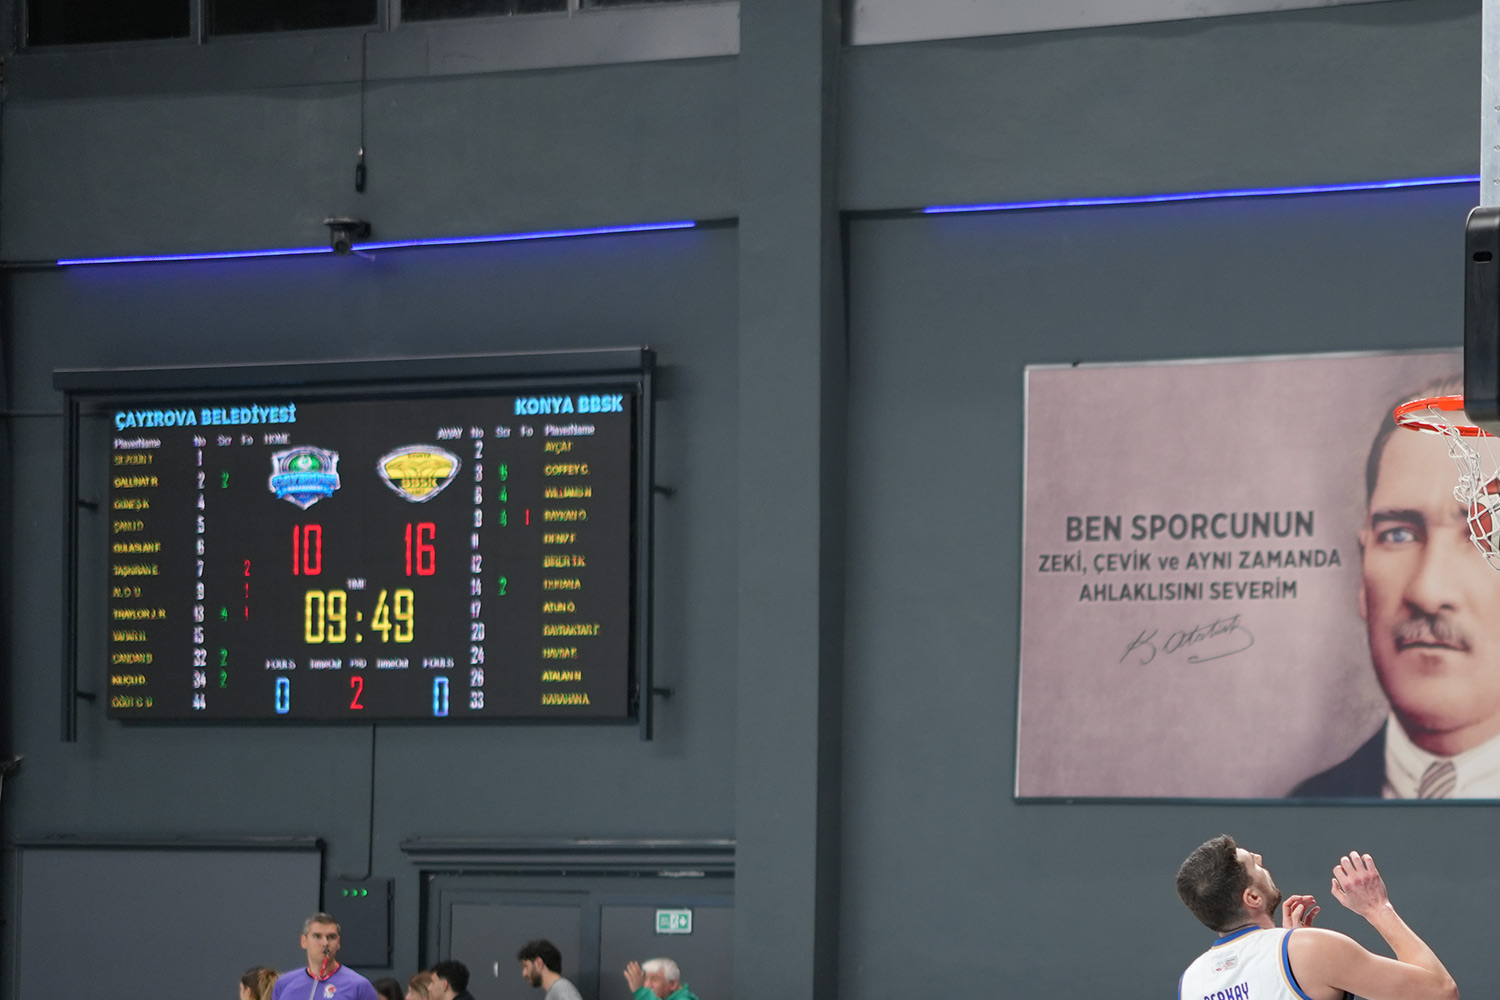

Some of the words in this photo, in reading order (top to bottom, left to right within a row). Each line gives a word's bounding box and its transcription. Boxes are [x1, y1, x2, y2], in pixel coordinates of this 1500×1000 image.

[514, 396, 574, 415] KONYA
[577, 395, 623, 414] BBSK
[115, 409, 198, 431] ÇAYIROVA
[201, 402, 297, 426] BELEDİYESİ
[437, 427, 463, 440] AWAY
[474, 440, 483, 459] 2
[474, 463, 483, 482] 3
[196, 515, 205, 533] 5
[1066, 515, 1122, 542] BEN
[1131, 511, 1314, 541] SPORCUNUN
[293, 524, 322, 576] 10
[405, 522, 436, 576] 16
[244, 559, 251, 576] 2
[470, 555, 482, 574] 12
[1038, 550, 1087, 575] ZEKİ,
[1093, 550, 1151, 575] ÇEVİK
[1158, 555, 1180, 571] ve
[1186, 551, 1232, 570] AYNI
[1239, 548, 1342, 569] ZAMANDA
[470, 577, 482, 596] 14
[1079, 582, 1203, 602] AHLAKLISINI
[1210, 577, 1298, 600] SEVERİM
[305, 589, 414, 643] 09:49
[470, 600, 481, 619] 17
[470, 622, 485, 641] 20
[193, 648, 208, 667] 32
[470, 645, 485, 664] 24
[192, 670, 207, 688] 34
[192, 692, 206, 710] 44
[276, 677, 290, 714] 0
[350, 676, 364, 710] 2
[433, 676, 449, 717] 0
[470, 690, 485, 709] 33
